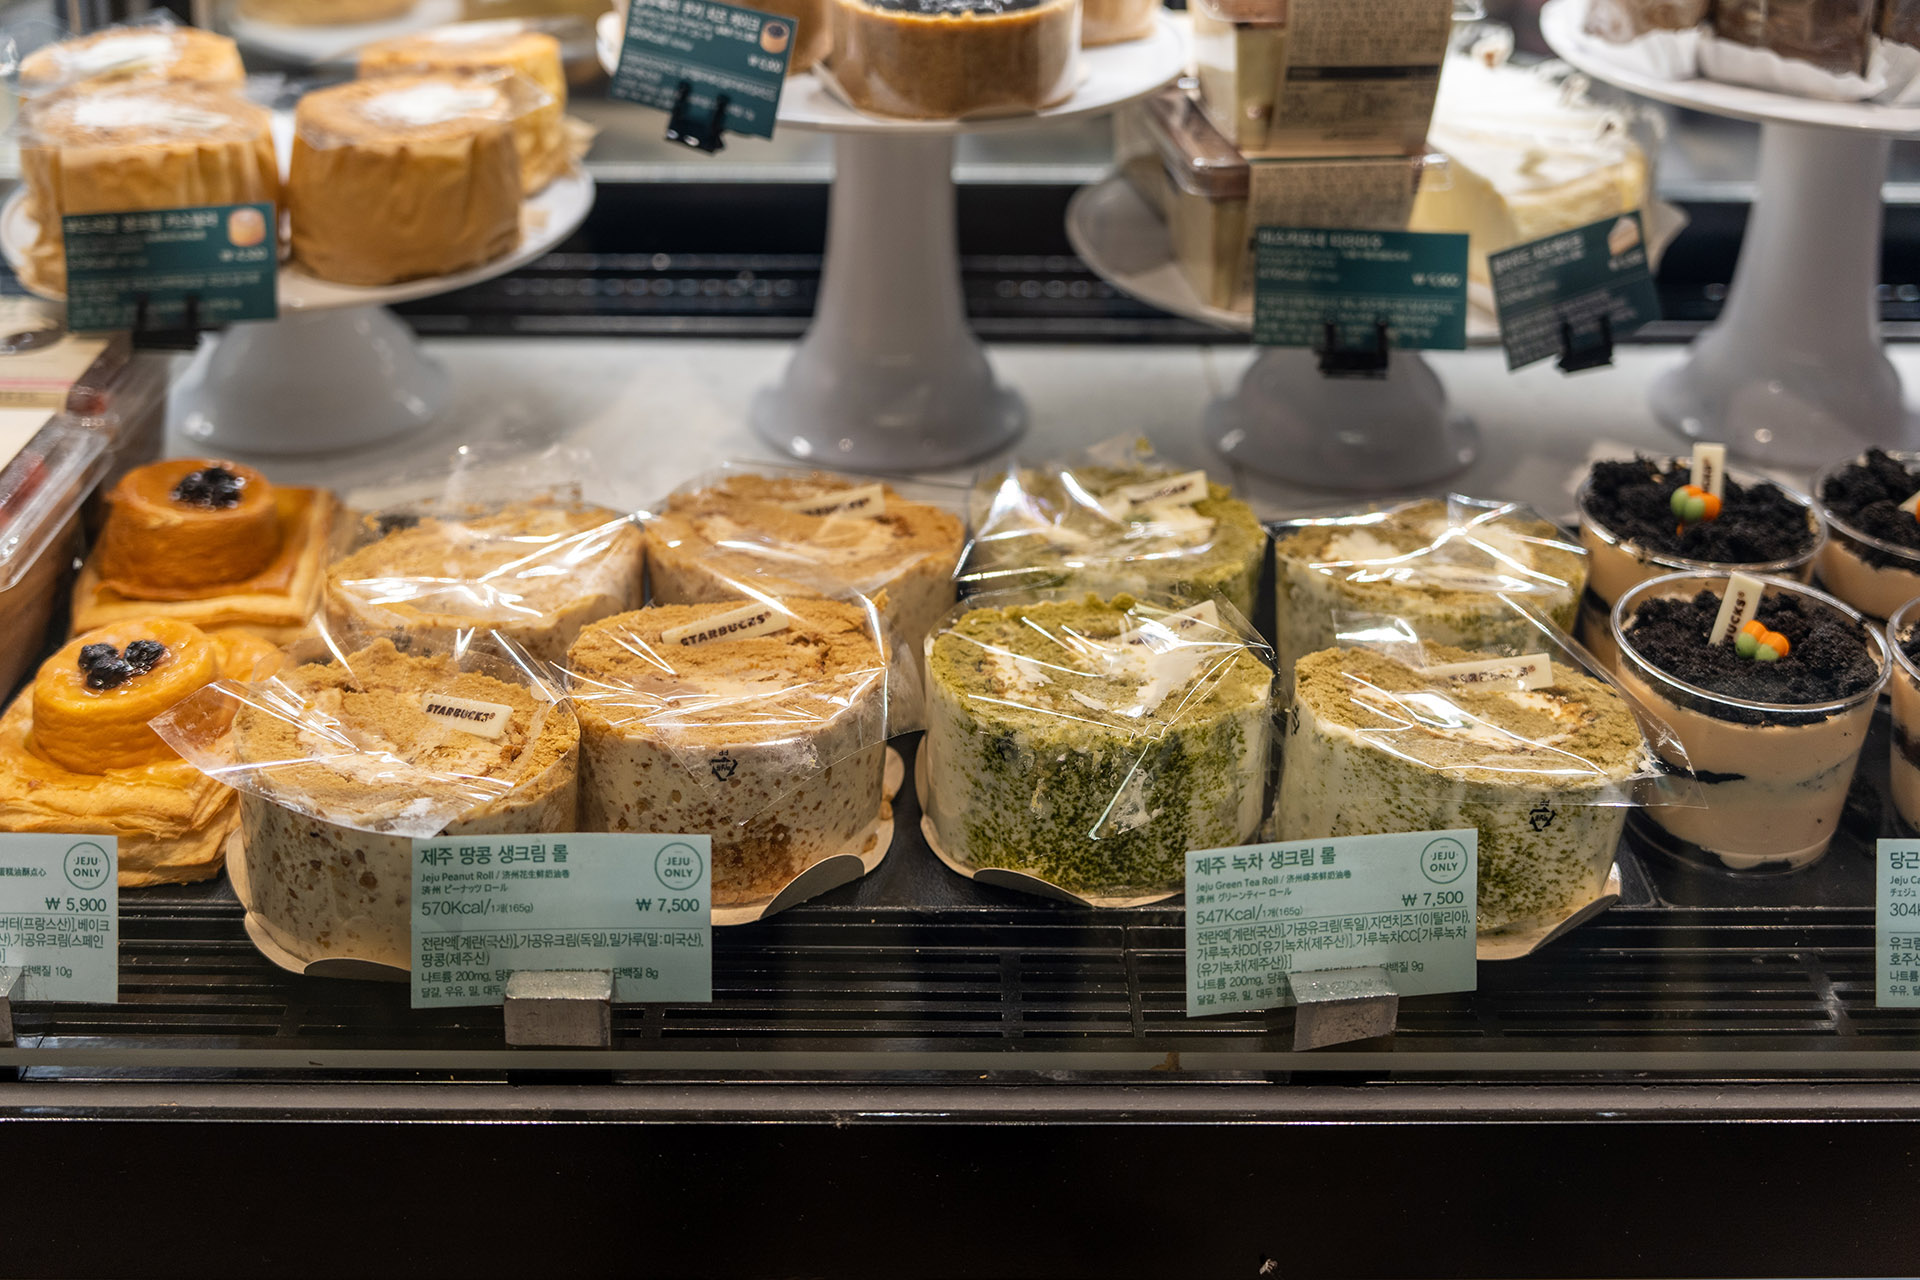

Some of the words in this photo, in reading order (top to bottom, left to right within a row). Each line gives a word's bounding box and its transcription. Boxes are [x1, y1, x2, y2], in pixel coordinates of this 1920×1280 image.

[421, 847, 454, 866] 제주
[460, 846, 493, 865] 땅콩
[498, 844, 546, 864] 생크림
[552, 844, 569, 862] 롤
[1195, 856, 1226, 876] 제주
[1231, 852, 1263, 873] 녹차
[1268, 848, 1314, 870] 생크림
[1320, 846, 1336, 865] 롤
[1432, 851, 1456, 861] JEJU
[75, 857, 98, 866] JEJU
[666, 857, 691, 866] JEJU
[1430, 862, 1458, 872] ONLY
[73, 868, 101, 878] ONLY
[421, 872, 440, 884] Jeju
[442, 871, 474, 882] Peanut
[476, 870, 494, 880] Roll
[664, 868, 693, 878] ONLY
[1196, 883, 1213, 894] Jeju
[1215, 880, 1243, 890] Green
[1245, 878, 1260, 888] Tea
[1262, 876, 1279, 886] Roll
[1889, 875, 1909, 886] Jeju
[484, 883, 508, 892] ロール
[1269, 887, 1292, 897] ロール
[1401, 893, 1418, 907] ₩
[1423, 890, 1464, 907] 7,500
[45, 897, 61, 911] ₩
[66, 898, 107, 913] 5,900
[635, 898, 652, 912] ₩
[657, 898, 700, 914] 7,500
[55, 966, 72, 978] 10g
[1411, 961, 1424, 973] 9g
[421, 971, 452, 983] 나트륨
[612, 967, 643, 979] 단백질
[645, 967, 659, 980] 8g
[1890, 970, 1919, 982] 나트륨
[1197, 976, 1226, 991] 나트륨
